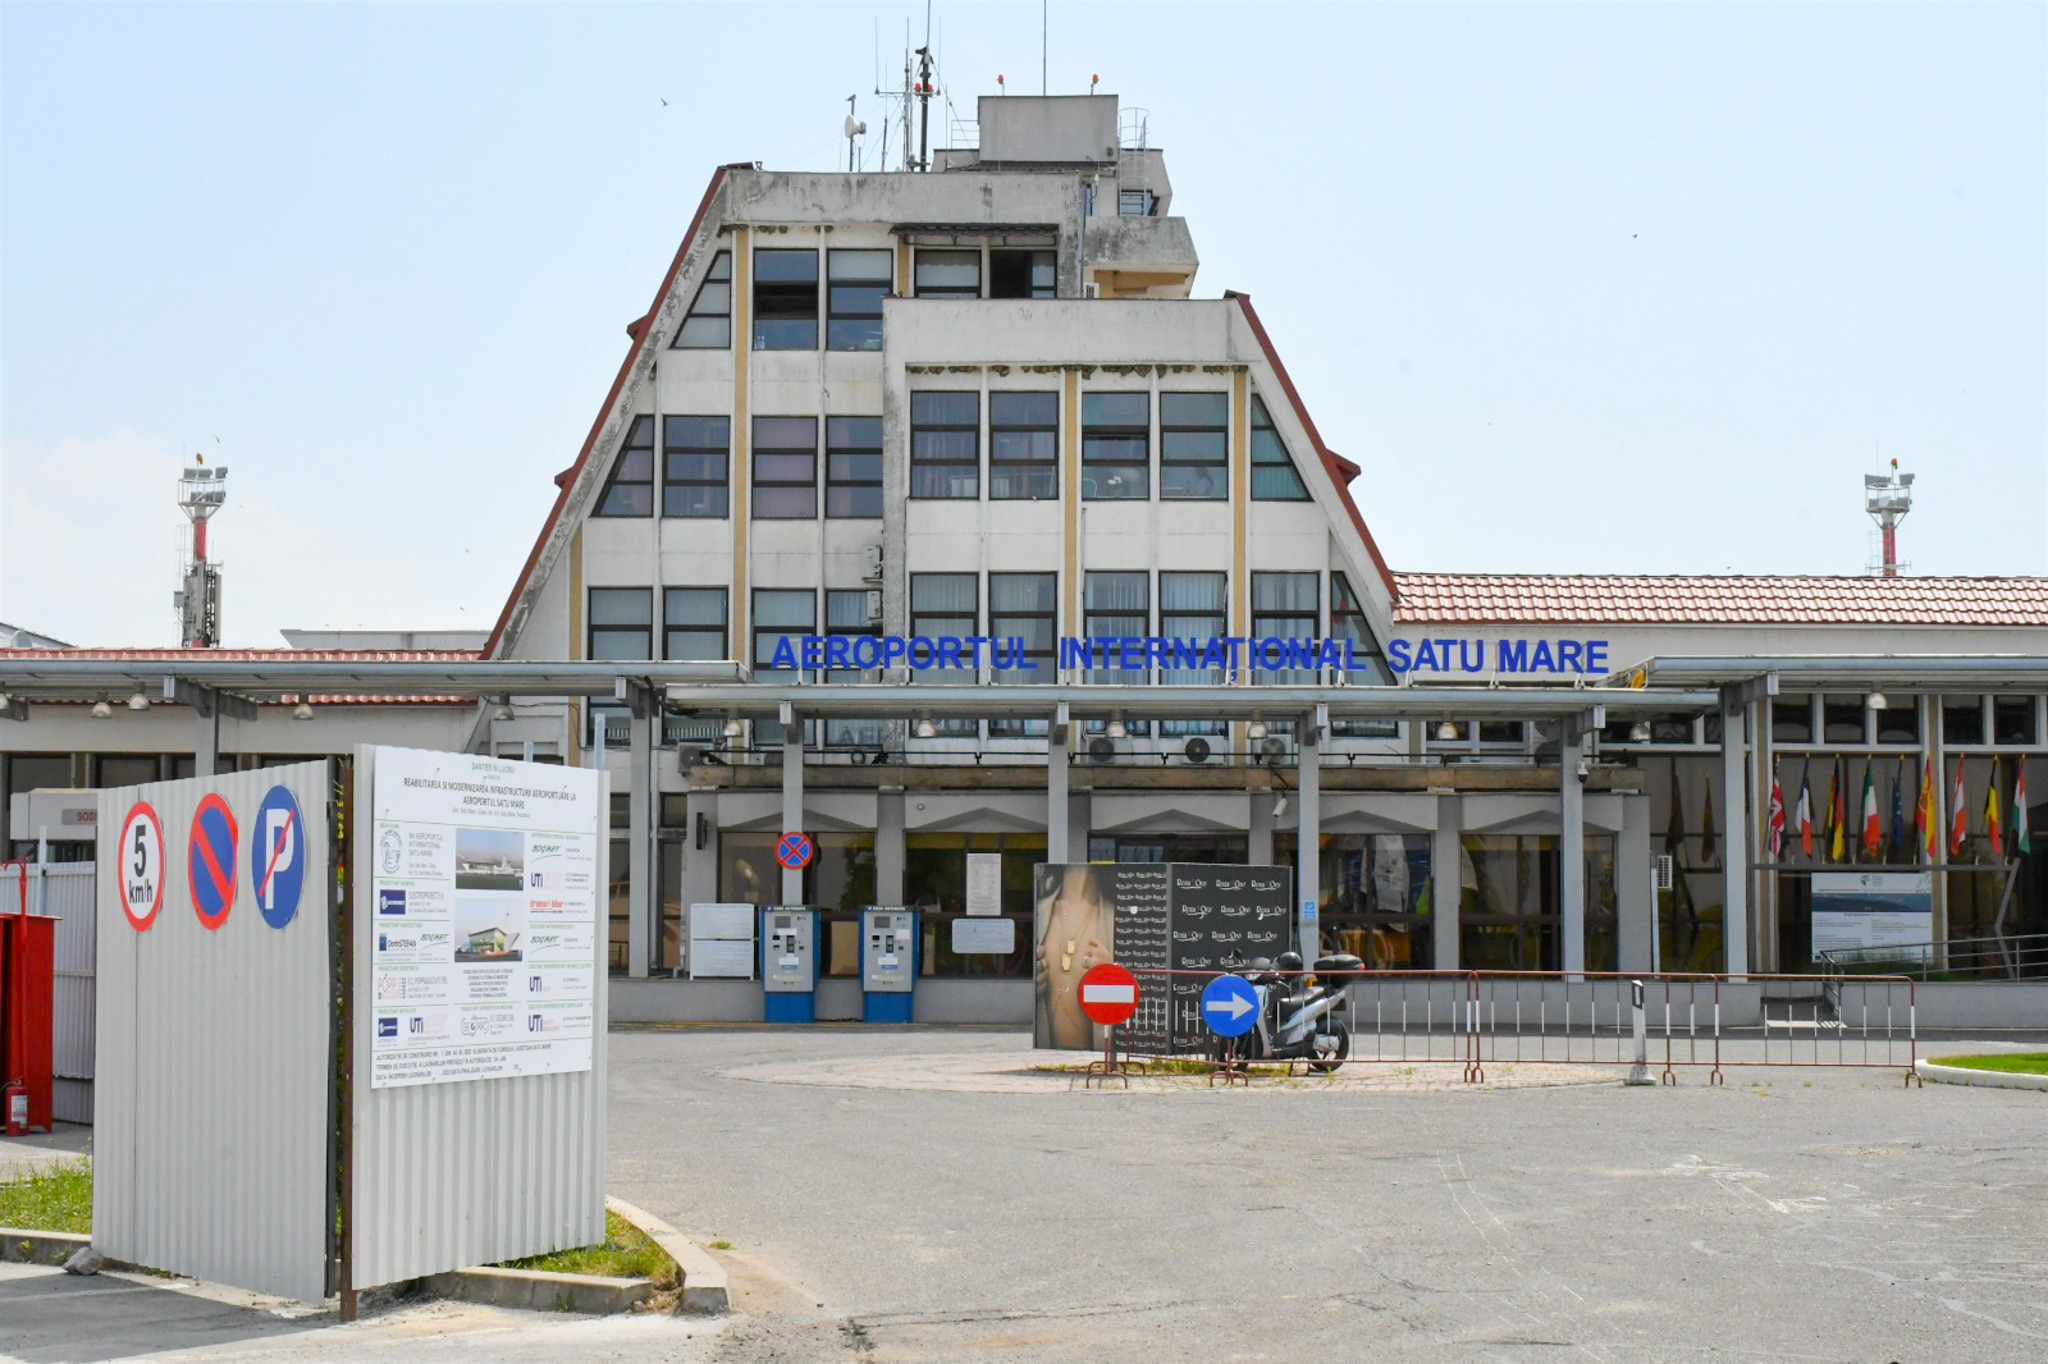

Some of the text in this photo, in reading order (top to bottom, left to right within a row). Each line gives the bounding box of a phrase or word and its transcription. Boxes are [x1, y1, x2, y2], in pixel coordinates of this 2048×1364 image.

[770, 634, 1609, 682] AEROPORTUL INTERNAȚIONAL SATU MARE
[403, 777, 441, 789] REABILITAREA
[448, 781, 489, 793] MODERNIZAREA
[463, 795, 526, 810] AEROPORTUL SATU MARE
[134, 824, 147, 878] 5
[264, 808, 294, 910] P
[128, 879, 152, 904] km/h
